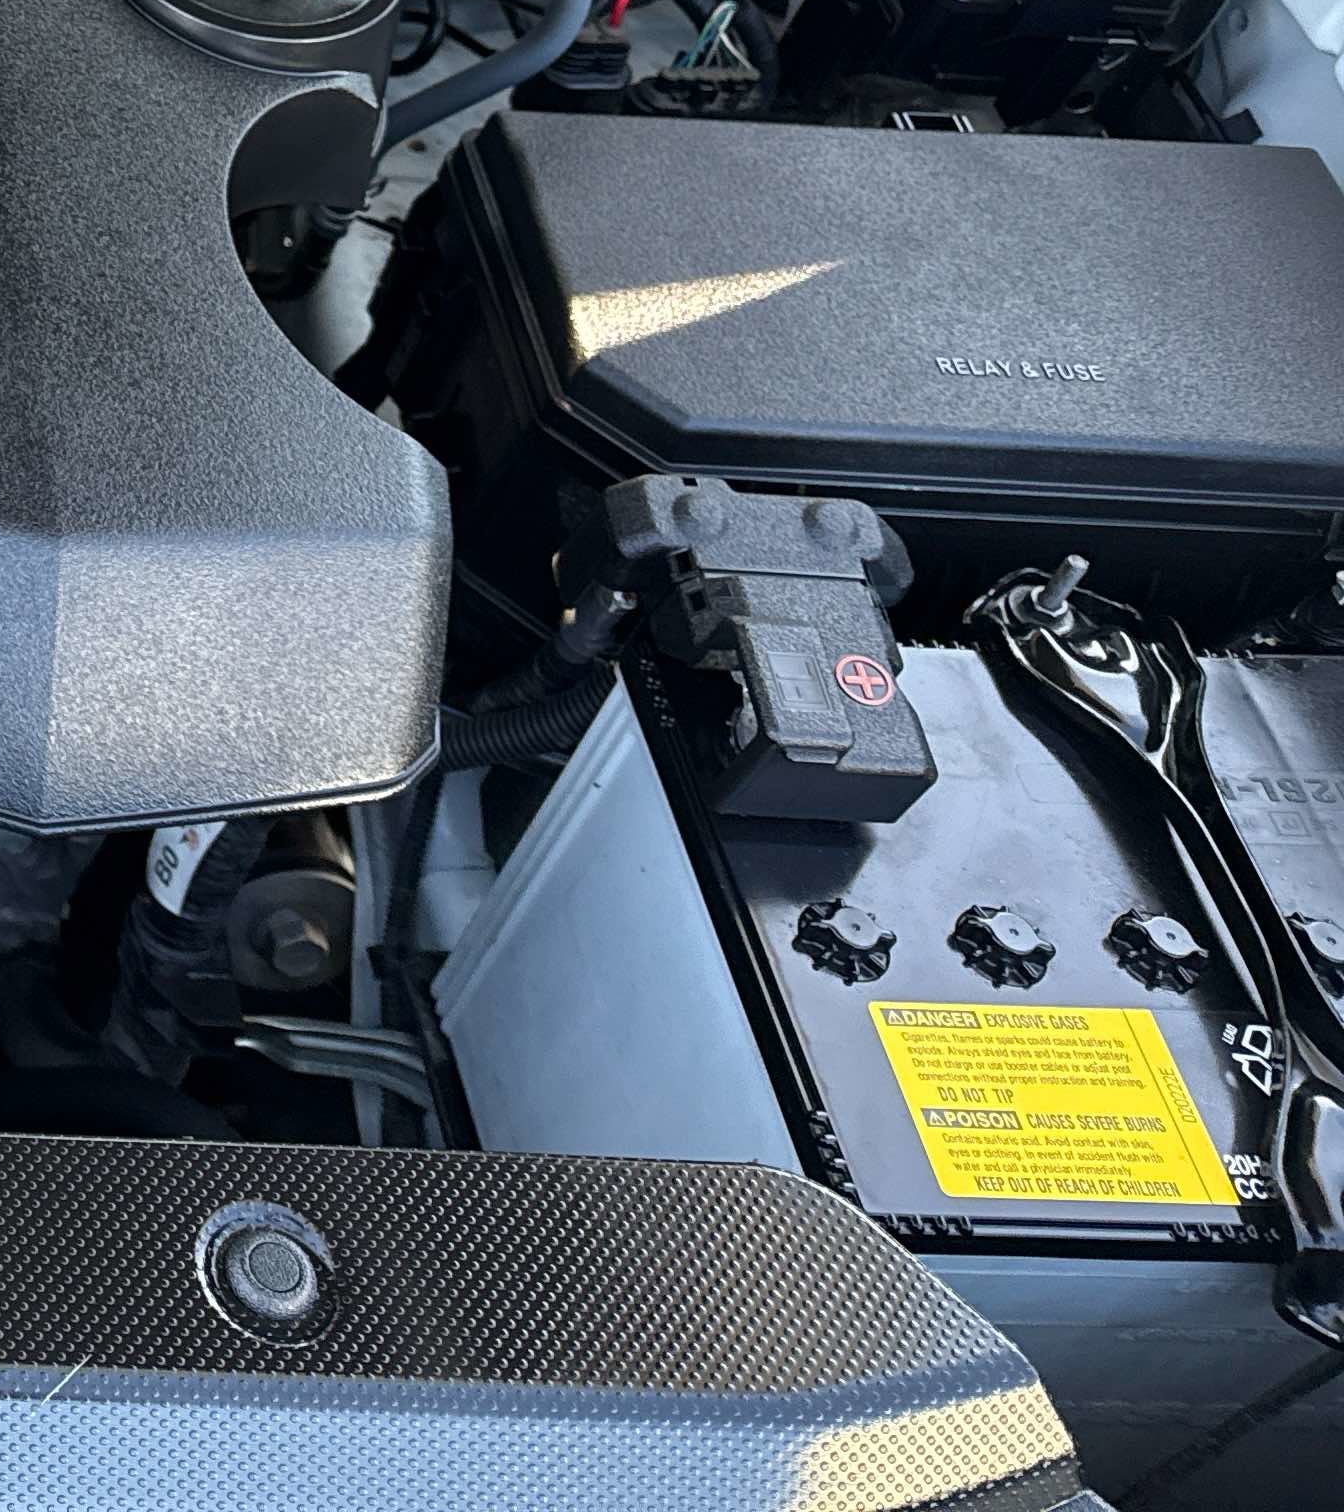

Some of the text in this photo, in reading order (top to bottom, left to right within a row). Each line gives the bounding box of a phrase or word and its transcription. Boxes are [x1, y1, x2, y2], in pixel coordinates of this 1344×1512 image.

[935, 357, 1107, 382] RELAY & FUSE
[901, 1011, 1090, 1030] DANGER EXPLOSIVE GASES
[1027, 1035, 1051, 1046] could
[1052, 1038, 1078, 1047] cause
[1079, 1038, 1112, 1049] battery
[1113, 1038, 1125, 1048] to
[947, 1046, 981, 1058] Always
[1034, 1050, 1051, 1059] and
[1052, 1050, 1072, 1059] face
[1073, 1050, 1094, 1060] from
[912, 1058, 925, 1068] Do
[927, 1059, 942, 1068] not
[943, 1060, 973, 1071] charge
[988, 1062, 1003, 1070] use
[1004, 1062, 1038, 1072] booster
[1083, 1061, 1110, 1074] adjust
[972, 1074, 1007, 1083] without
[1008, 1076, 1037, 1086] proper
[1089, 1077, 1106, 1086] and
[937, 1087, 1014, 1104] DO NOT TIP
[943, 1111, 1167, 1133] POISON CAUSES SEVERE BURNS
[942, 1133, 982, 1145] Contains
[1045, 1136, 1070, 1147] Avoid
[1073, 1137, 1106, 1148] contact
[1107, 1138, 1130, 1148] with
[948, 1149, 970, 1159] eyes
[1038, 1151, 1062, 1160] event
[1077, 1152, 1115, 1162] accident
[1116, 1152, 1140, 1163] flush
[1141, 1154, 1164, 1164] with
[952, 1162, 981, 1172] water
[983, 1163, 1000, 1173] and
[1002, 1163, 1019, 1173] call
[1030, 1164, 1073, 1175] physician
[974, 1176, 1182, 1198] KEEP OUT OF REACH OF CHILDREN
